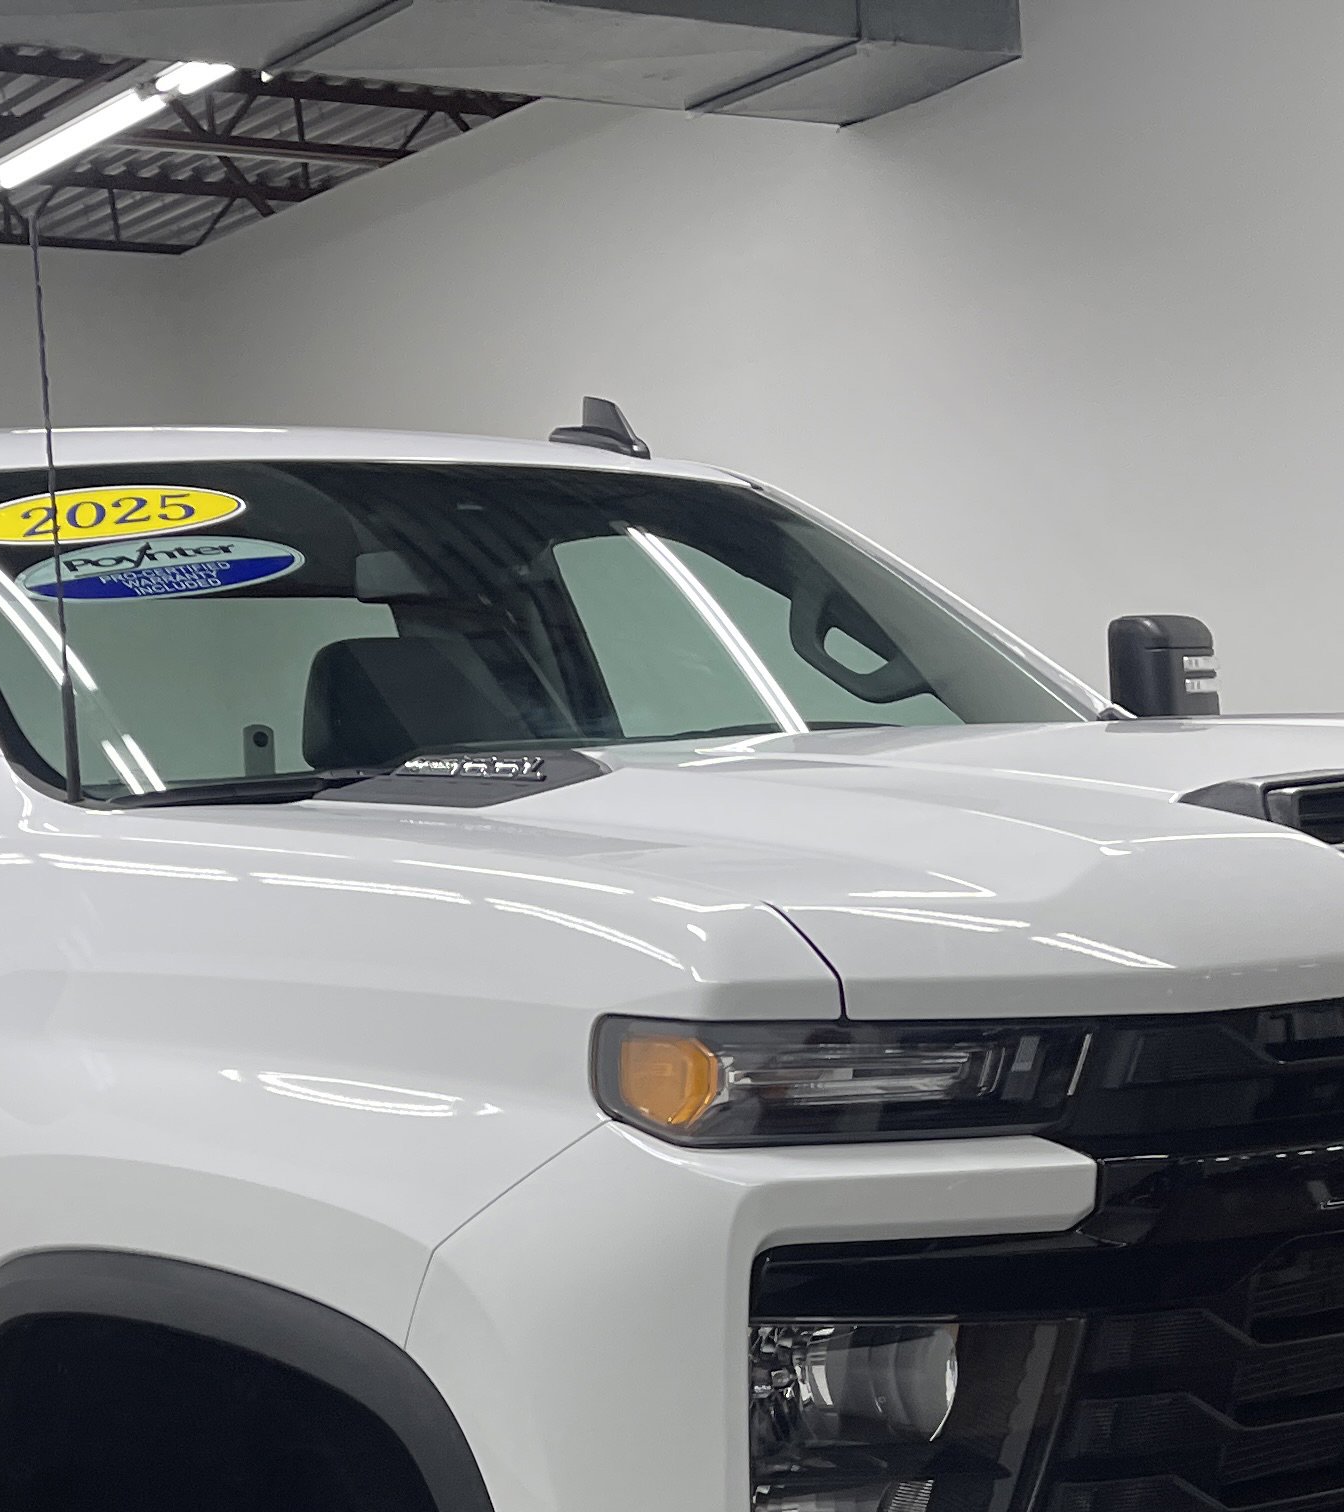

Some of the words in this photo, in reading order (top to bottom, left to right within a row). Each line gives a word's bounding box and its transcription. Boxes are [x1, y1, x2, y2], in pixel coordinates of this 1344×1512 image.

[20, 493, 196, 538] 2025
[61, 541, 235, 577] Poynter
[122, 570, 219, 590] WARRANTY
[134, 577, 222, 597] INCLUDED
